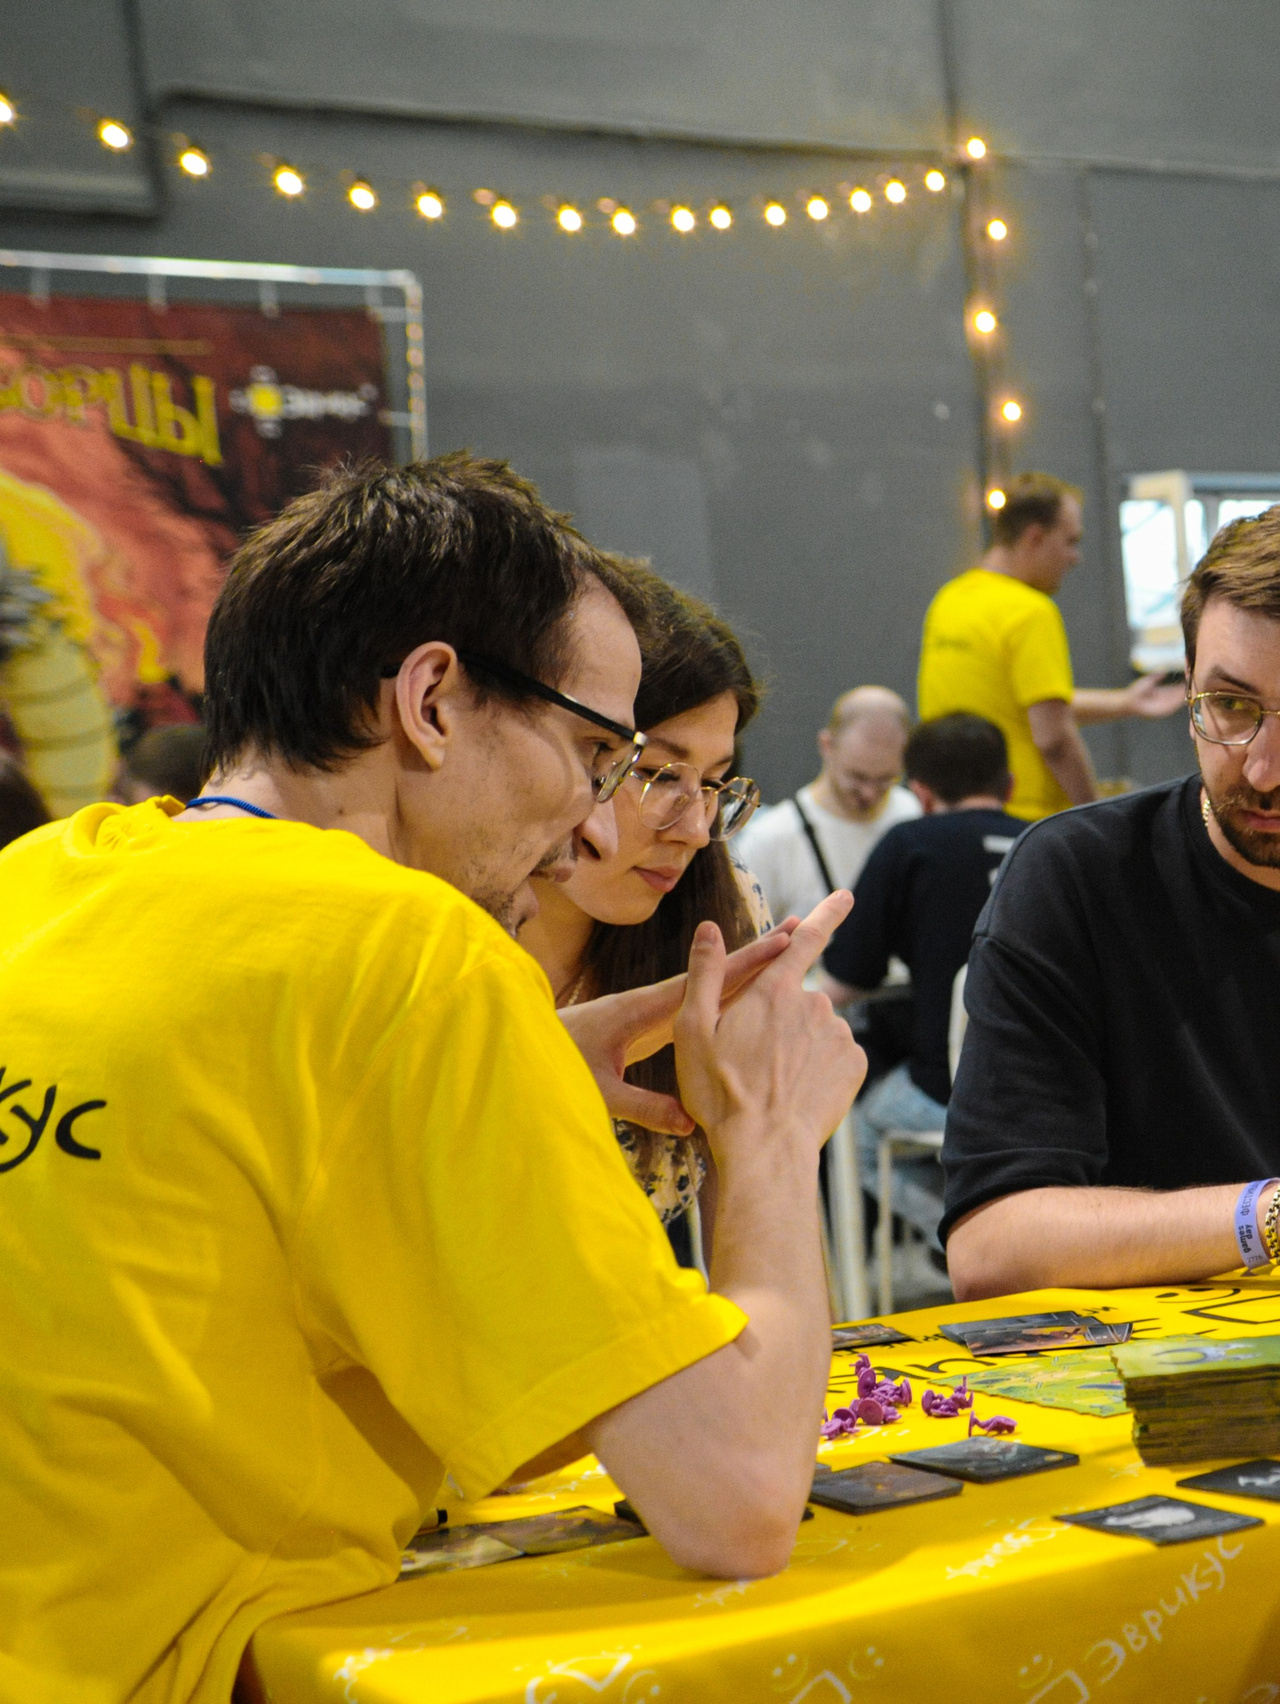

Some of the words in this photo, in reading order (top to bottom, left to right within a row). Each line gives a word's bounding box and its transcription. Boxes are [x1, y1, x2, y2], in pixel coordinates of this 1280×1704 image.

[1238, 1225, 1252, 1253] games
[1245, 1224, 1253, 1240] day
[1083, 1535, 1245, 1686] Эврикус
